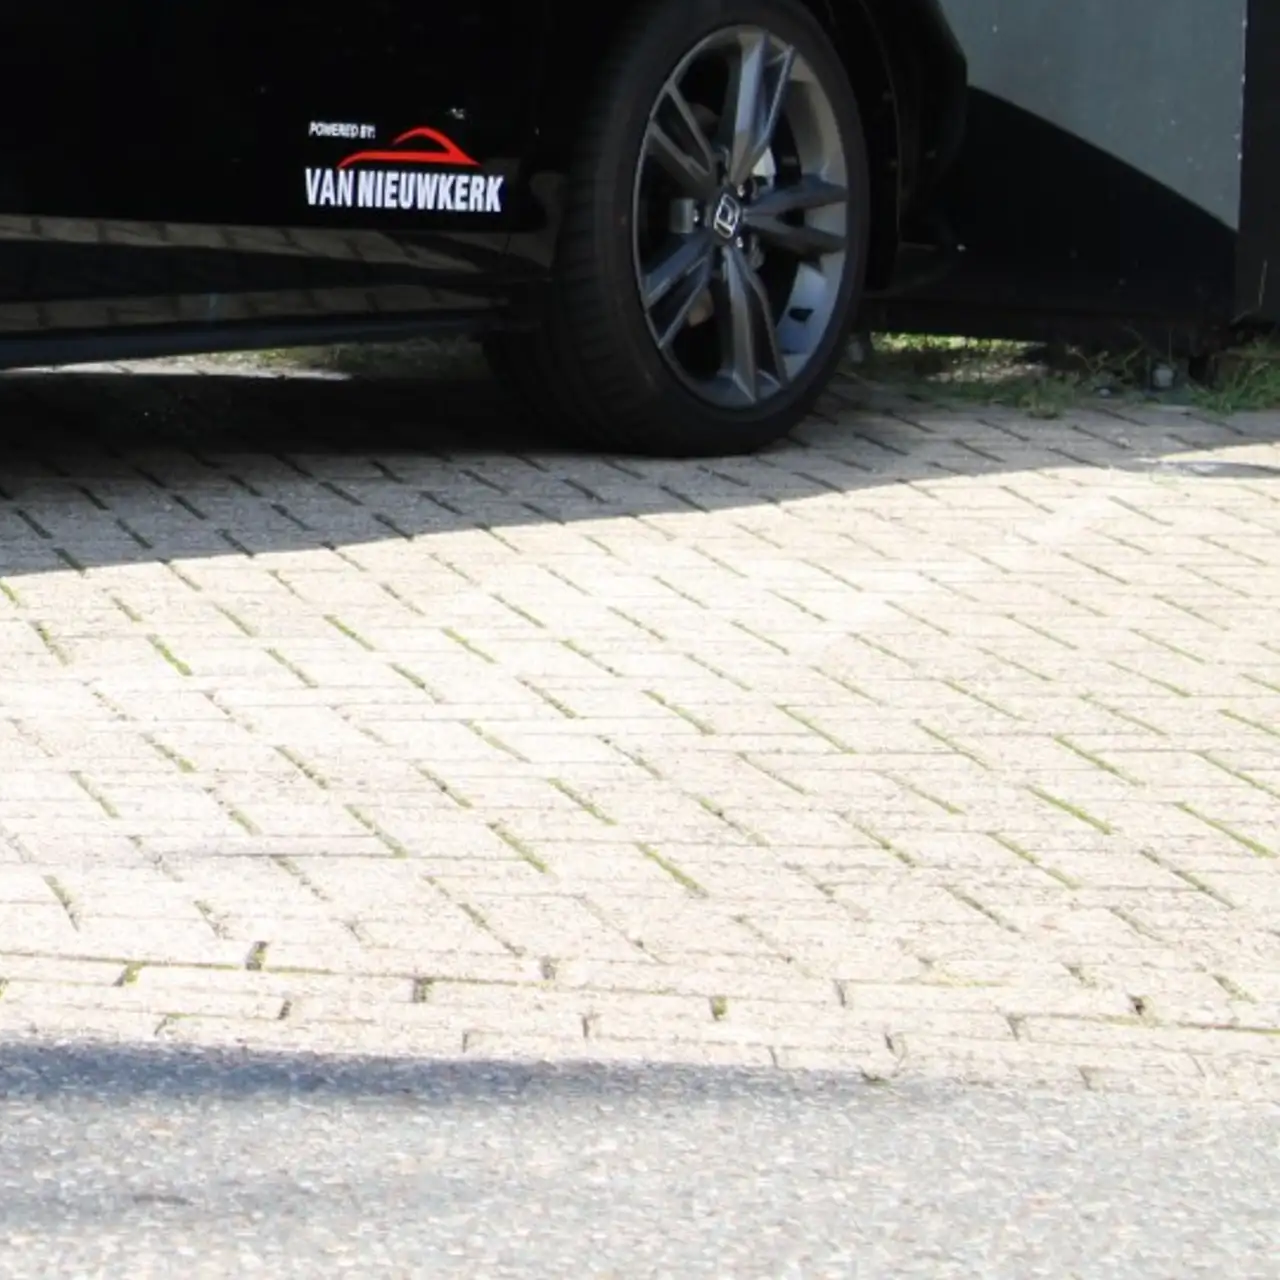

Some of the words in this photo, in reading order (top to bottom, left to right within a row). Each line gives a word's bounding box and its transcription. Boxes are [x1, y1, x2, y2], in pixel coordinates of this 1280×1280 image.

[309, 121, 358, 138] POWERED
[305, 167, 353, 207] VAN
[357, 170, 504, 212] NIEUWKERK
